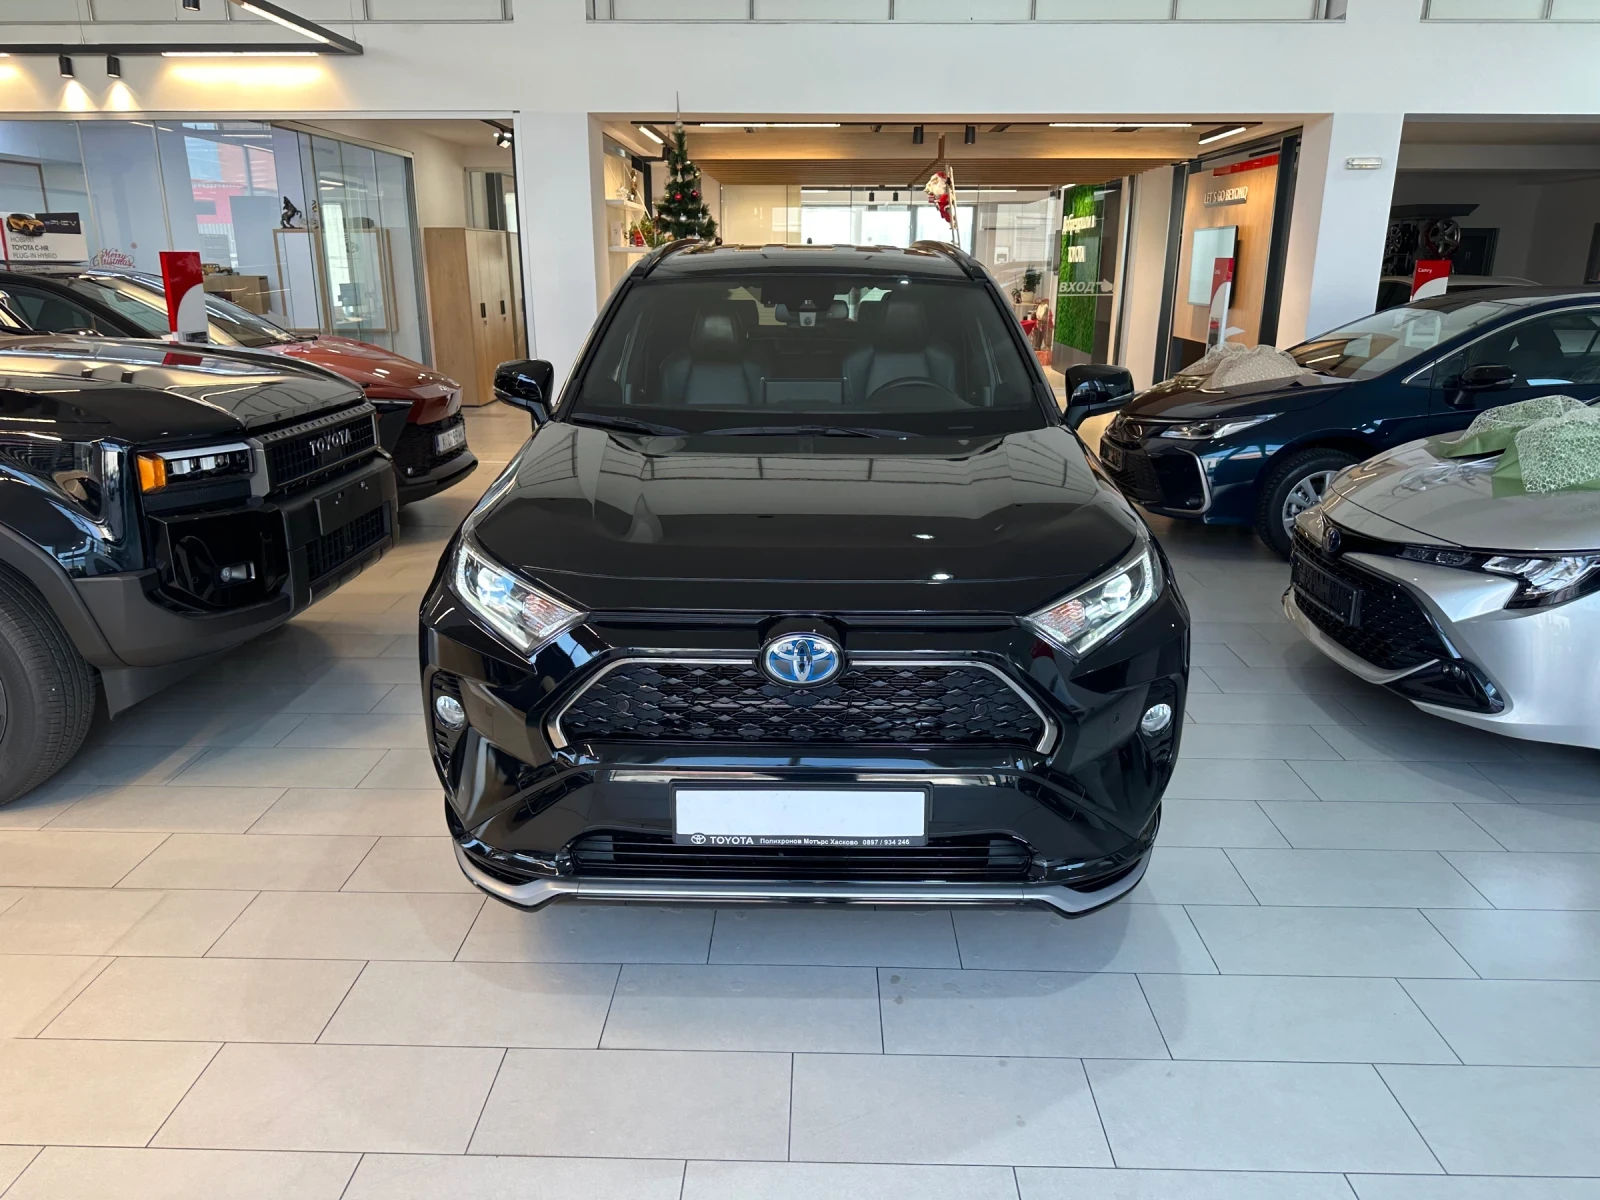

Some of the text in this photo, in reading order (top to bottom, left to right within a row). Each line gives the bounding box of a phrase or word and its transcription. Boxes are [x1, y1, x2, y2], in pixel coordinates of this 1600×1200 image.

[1226, 186, 1248, 201] BEYOND
[101, 247, 127, 260] Merry
[1059, 281, 1095, 294] ВХОД
[309, 428, 352, 456] TOYOTA
[710, 836, 754, 845] TOYOTA
[760, 838, 802, 846] Полихронов
[803, 838, 829, 846] Мотърс
